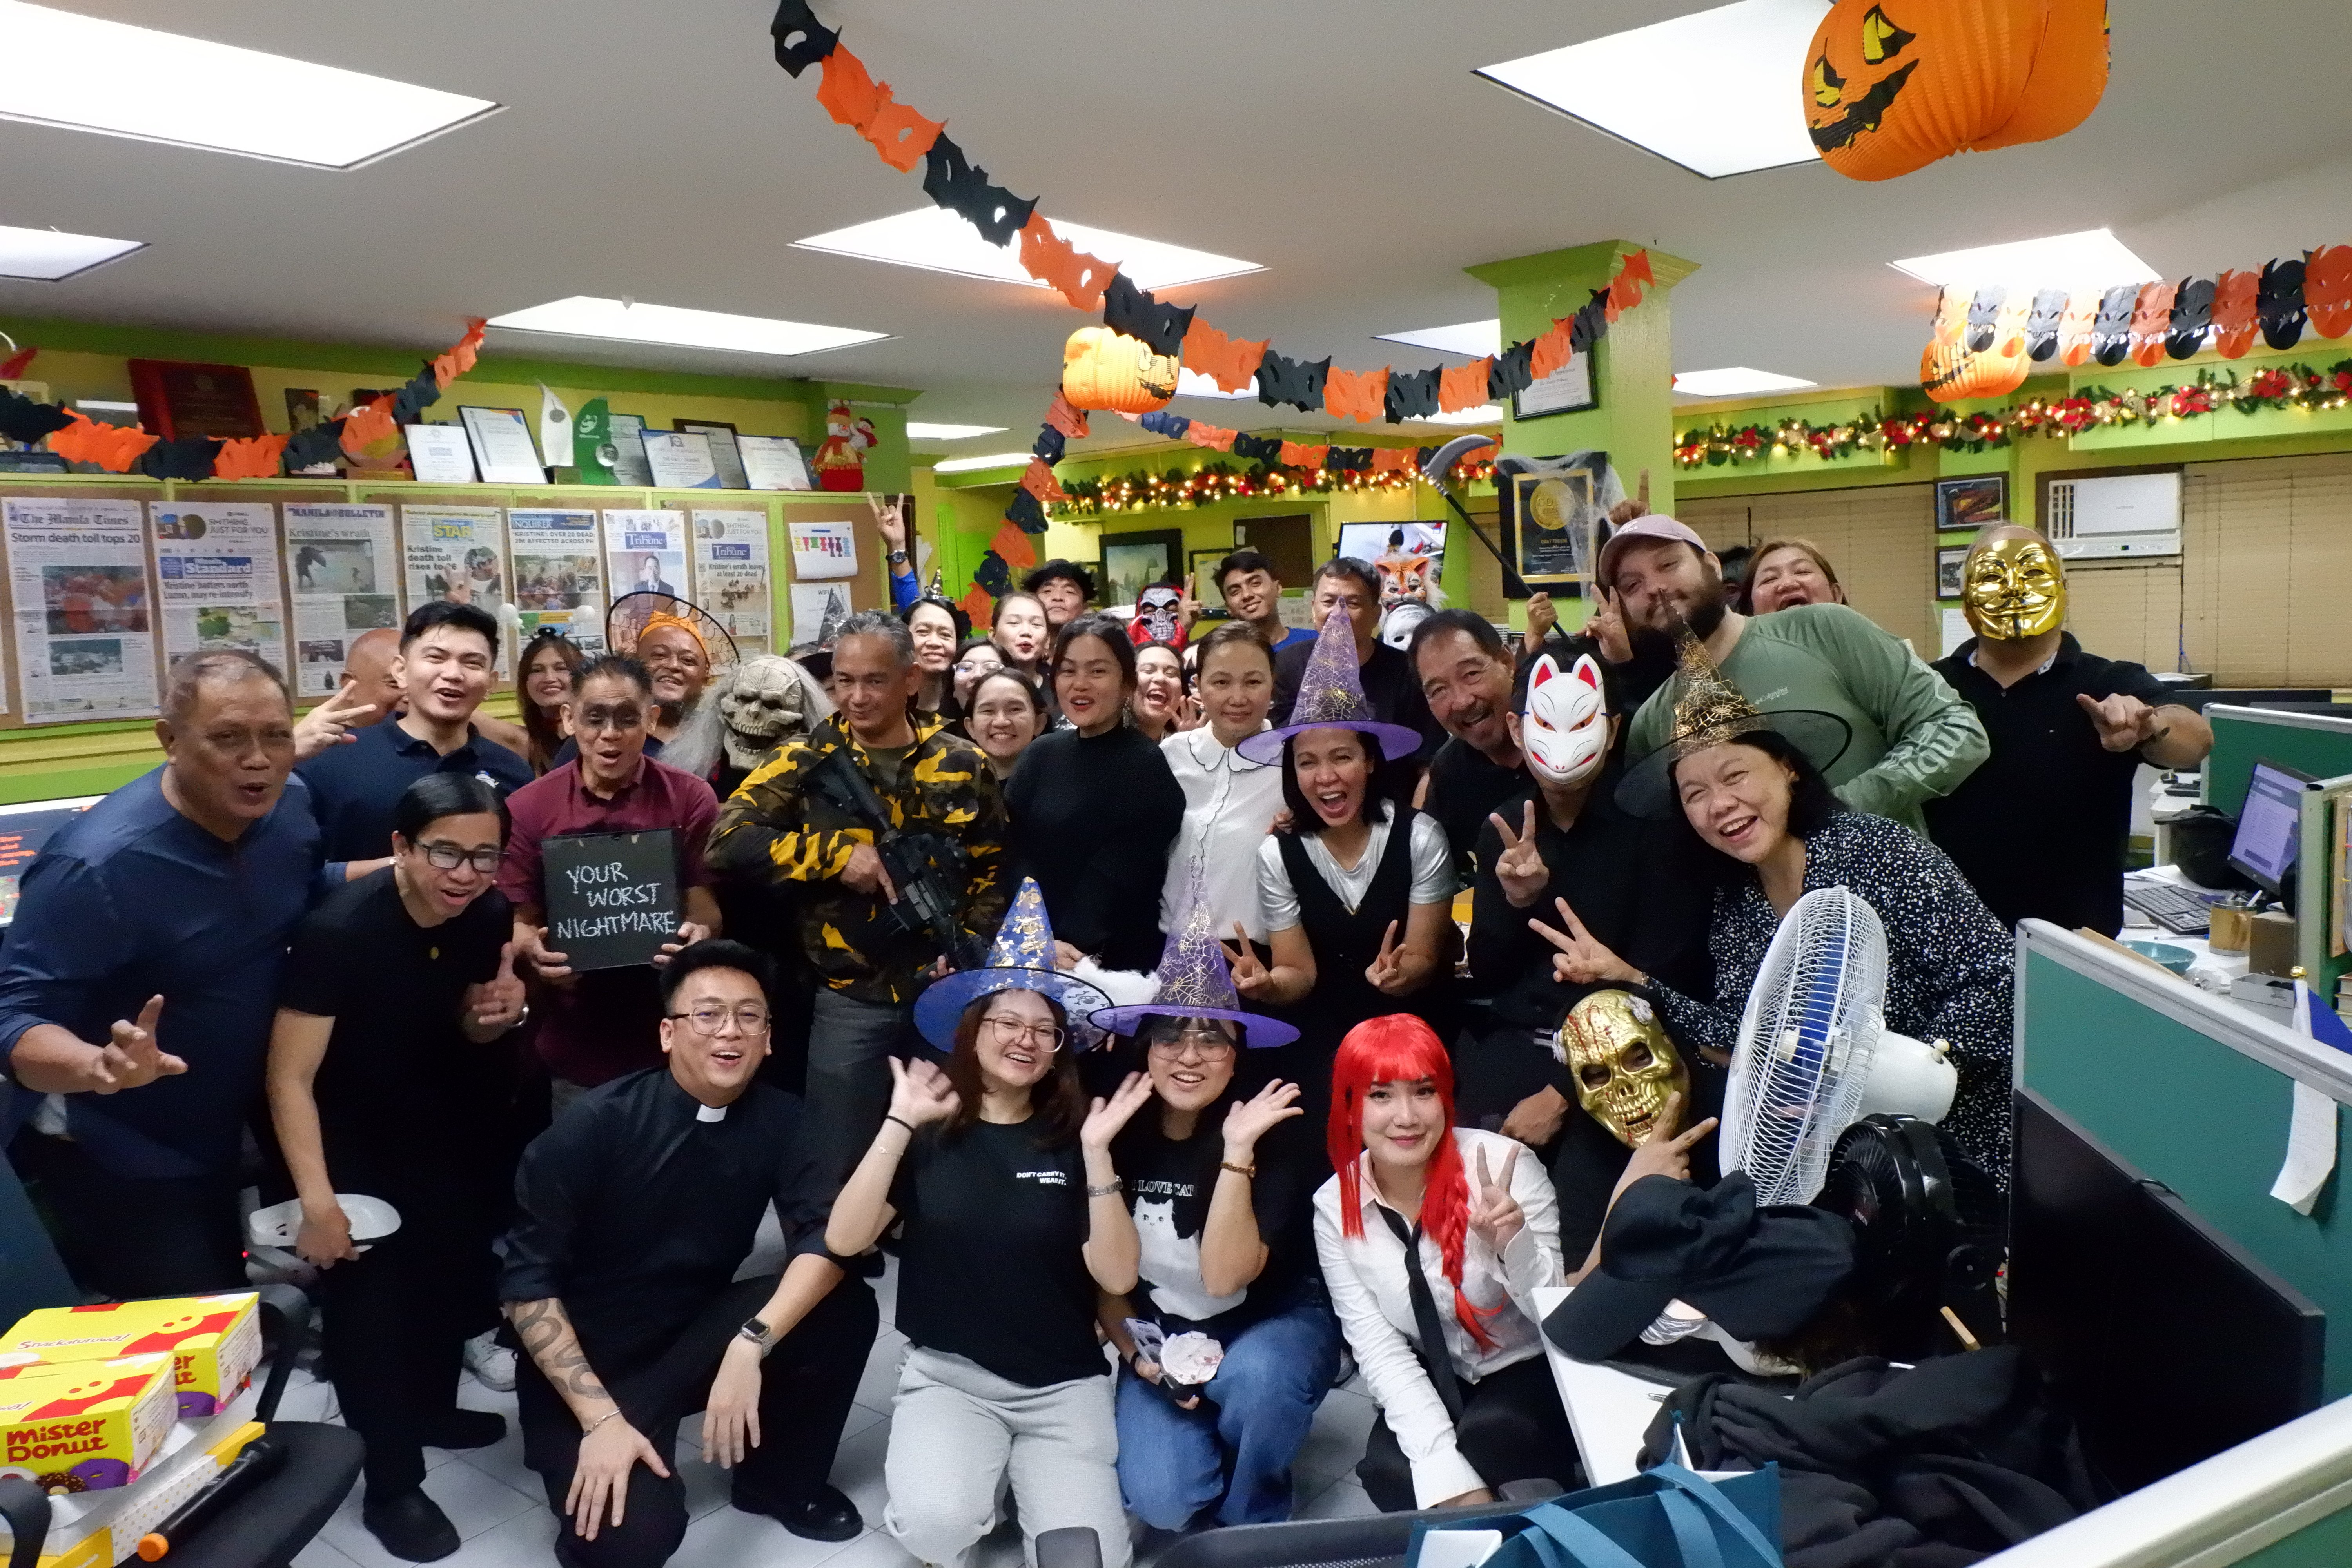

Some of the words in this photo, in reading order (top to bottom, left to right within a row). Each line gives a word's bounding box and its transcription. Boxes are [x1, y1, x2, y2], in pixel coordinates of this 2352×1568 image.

[433, 525, 471, 538] STAR
[12, 533, 45, 543] Storm
[48, 533, 80, 543] death
[82, 534, 100, 543] toll
[101, 534, 125, 545] tops
[127, 534, 140, 543] 20
[627, 534, 663, 545] Tribune
[713, 545, 747, 556] Tribune
[185, 562, 252, 573] Standard
[566, 862, 628, 894] YOUR
[586, 882, 662, 907] WORST
[557, 910, 677, 939] NIGHTMARE
[1137, 1180, 1173, 1194] LOVE
